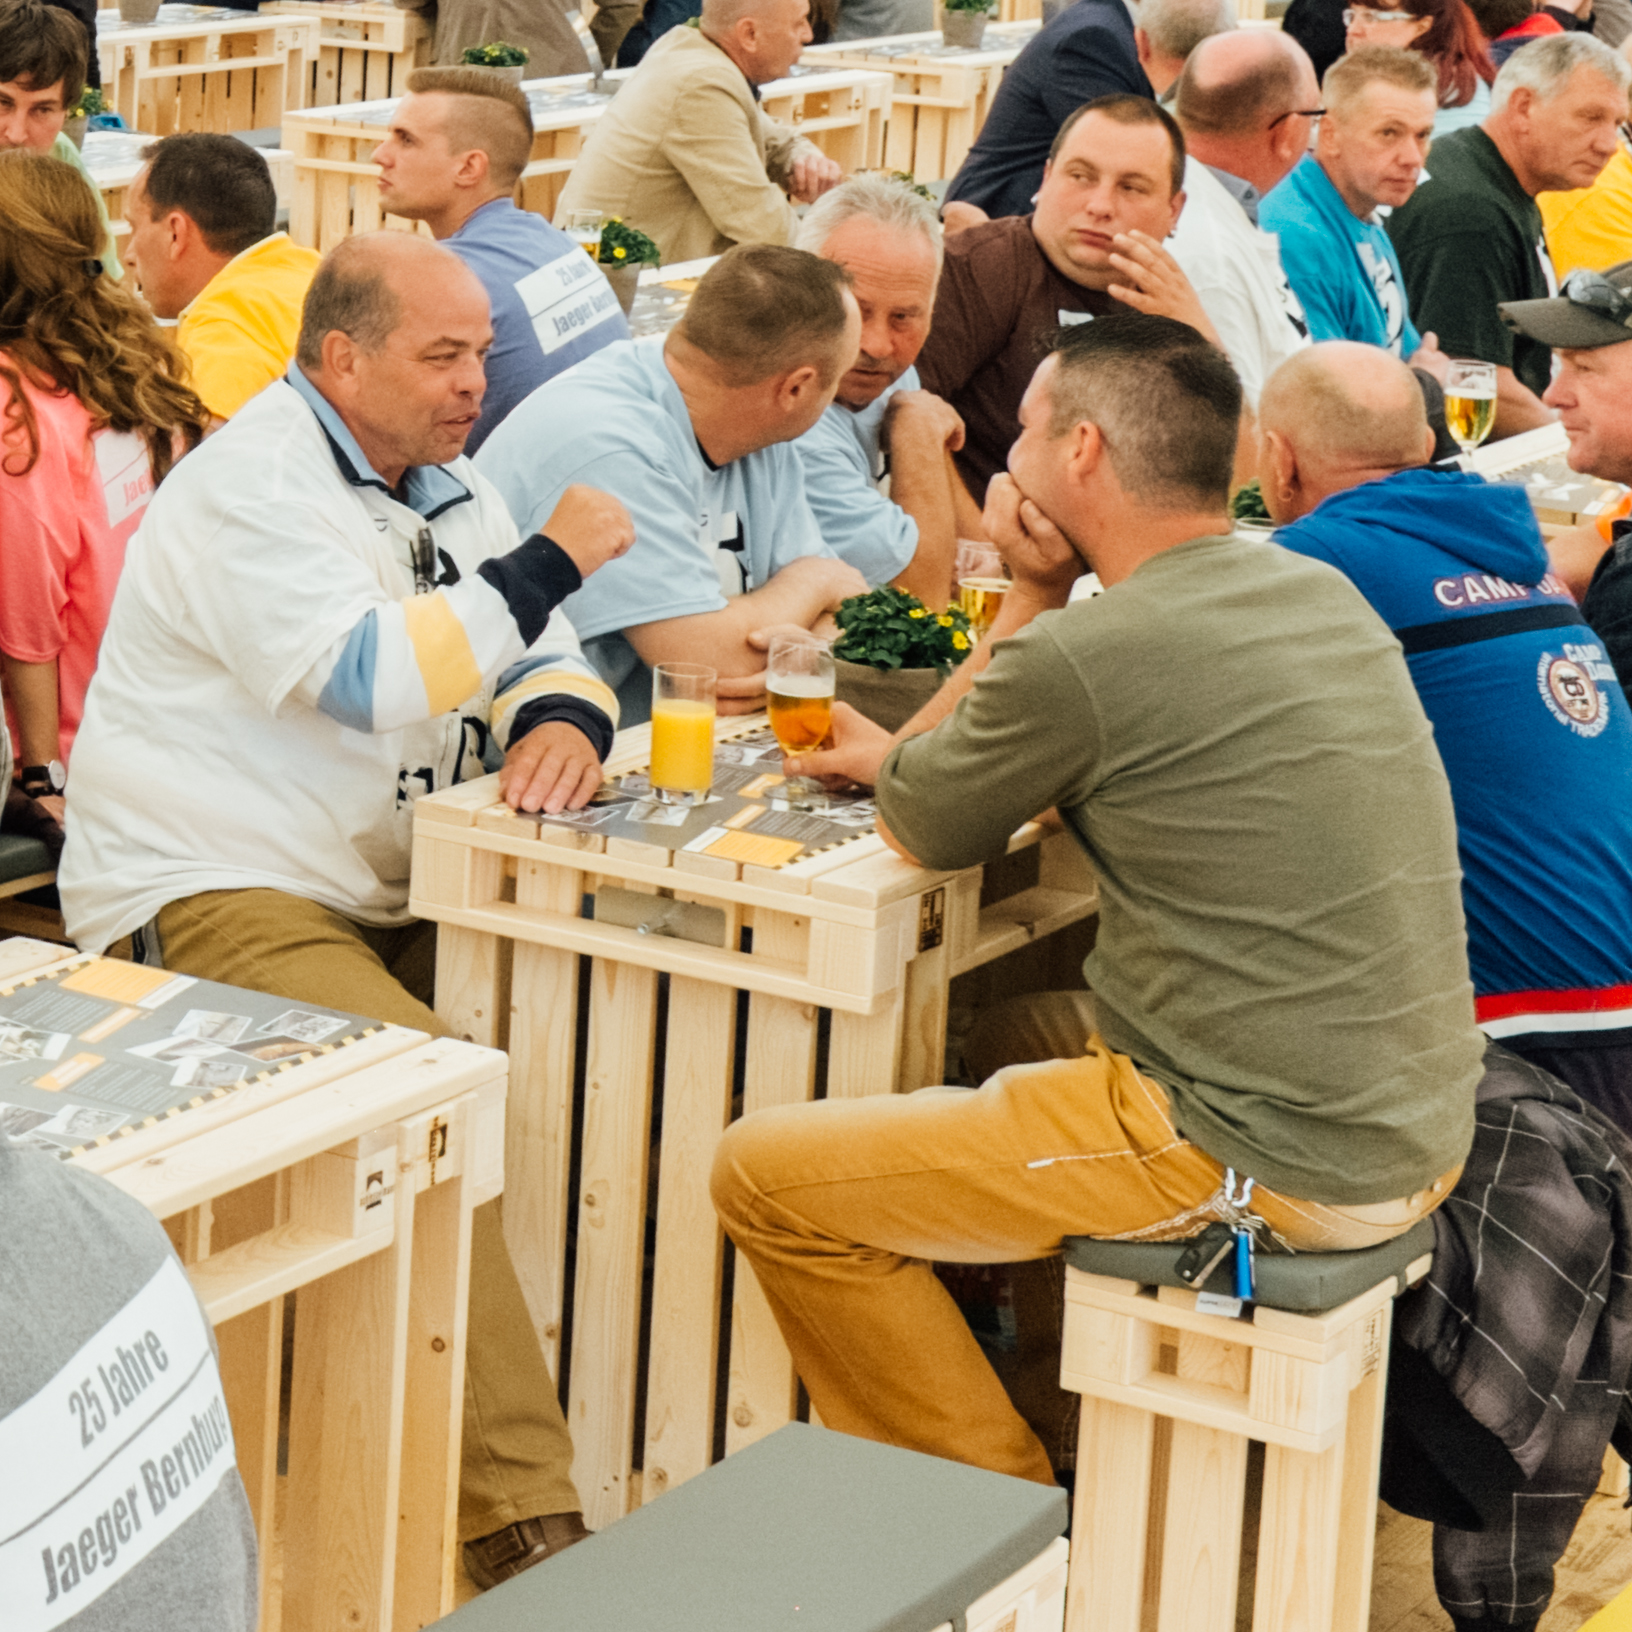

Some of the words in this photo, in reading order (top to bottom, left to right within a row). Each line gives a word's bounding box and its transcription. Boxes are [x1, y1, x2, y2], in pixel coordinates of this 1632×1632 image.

[552, 302, 595, 337] Jaeger
[69, 1377, 108, 1450] 25
[97, 1330, 169, 1417] Jahre
[41, 1483, 142, 1606] Jaeger
